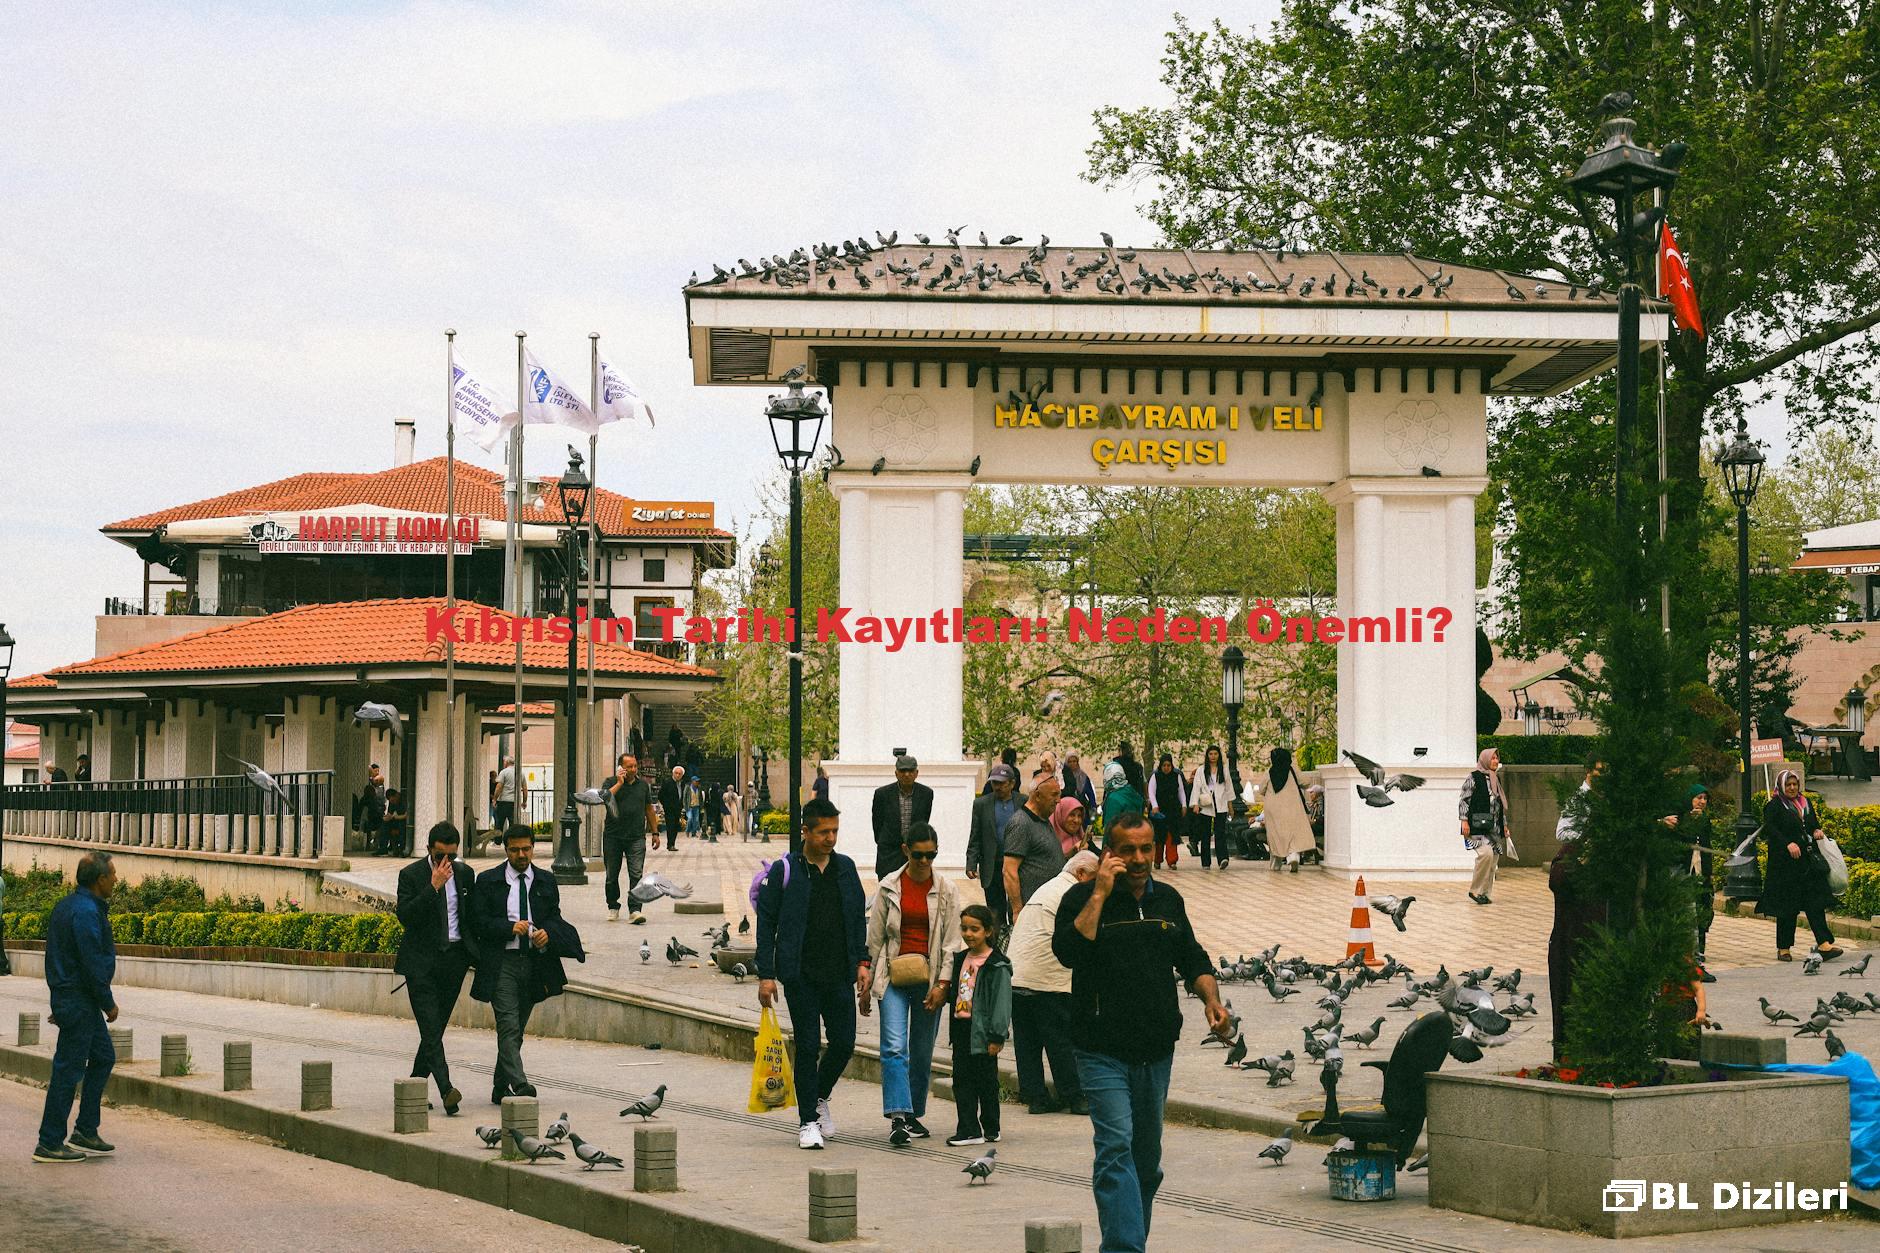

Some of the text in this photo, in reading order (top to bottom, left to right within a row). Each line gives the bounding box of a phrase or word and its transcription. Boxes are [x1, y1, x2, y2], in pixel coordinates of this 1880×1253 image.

[460, 385, 492, 408] ANKARA
[1092, 439, 1227, 471] ÇARŞISI
[632, 506, 686, 522] Ziyafet
[299, 516, 390, 542] HARPUT
[322, 542, 342, 552] ODUN
[399, 543, 408, 553] VE
[410, 543, 434, 553] KEBAP
[1850, 565, 1880, 574] KEBAP
